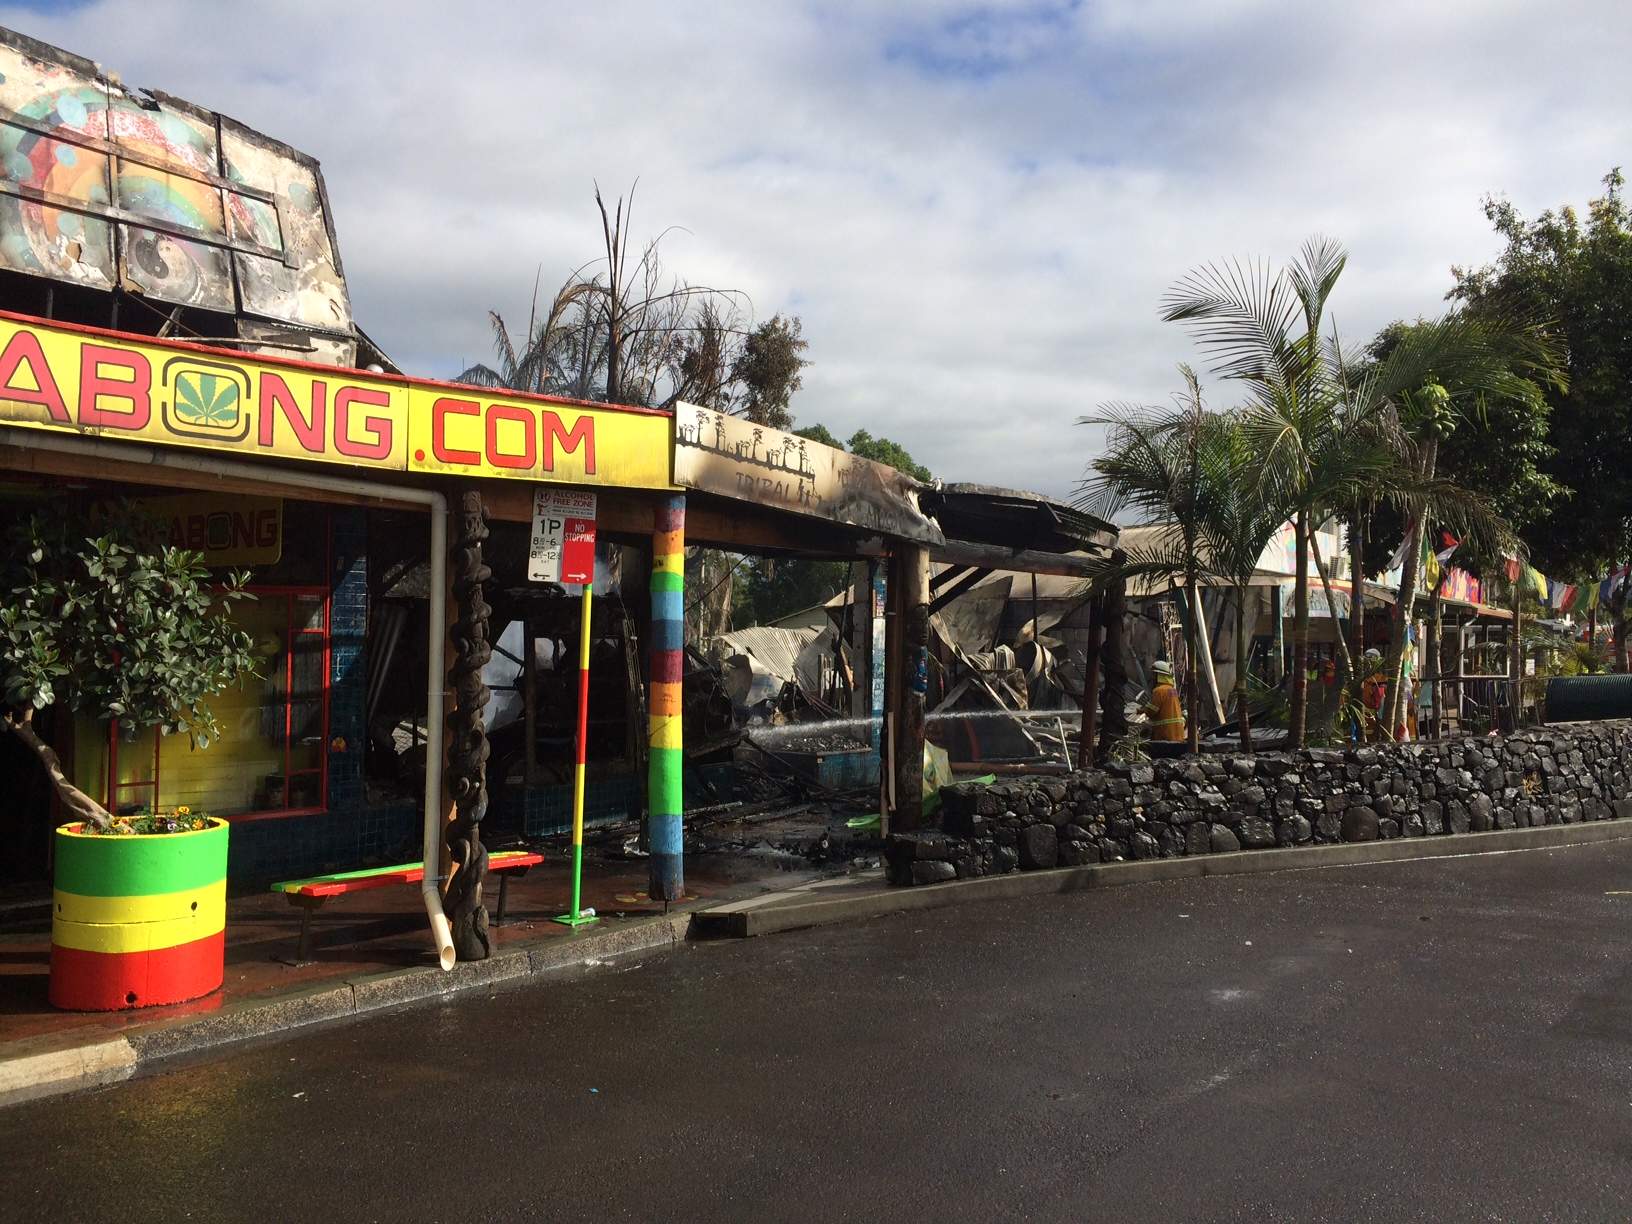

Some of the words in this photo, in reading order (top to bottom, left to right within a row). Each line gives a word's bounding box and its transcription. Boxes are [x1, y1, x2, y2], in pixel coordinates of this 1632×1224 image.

[553, 497, 571, 506] FREE
[573, 499, 593, 508] ZONE
[540, 519, 561, 535] 1P
[575, 524, 585, 533] NO
[565, 532, 595, 543] STOPPING
